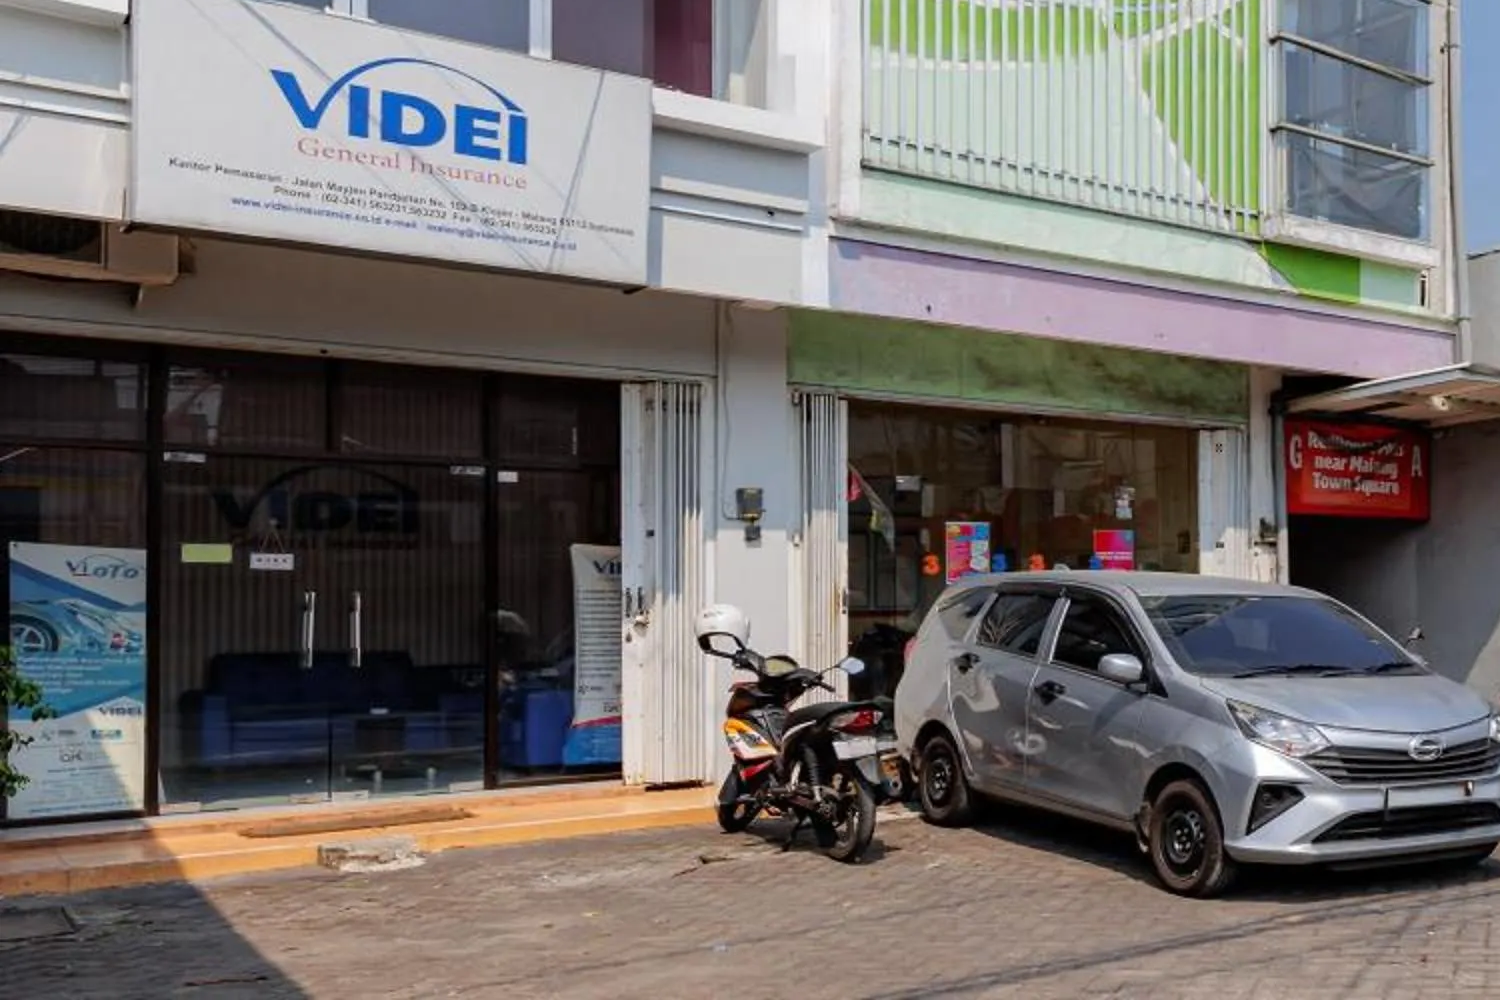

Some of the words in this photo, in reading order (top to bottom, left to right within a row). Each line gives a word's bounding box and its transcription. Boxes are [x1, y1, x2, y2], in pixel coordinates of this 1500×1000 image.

[270, 58, 527, 165] VIDEI
[297, 136, 400, 170] General
[410, 154, 528, 189] Insurance
[1314, 454, 1348, 472] near
[1312, 471, 1352, 490] Town
[1354, 475, 1400, 497] Square
